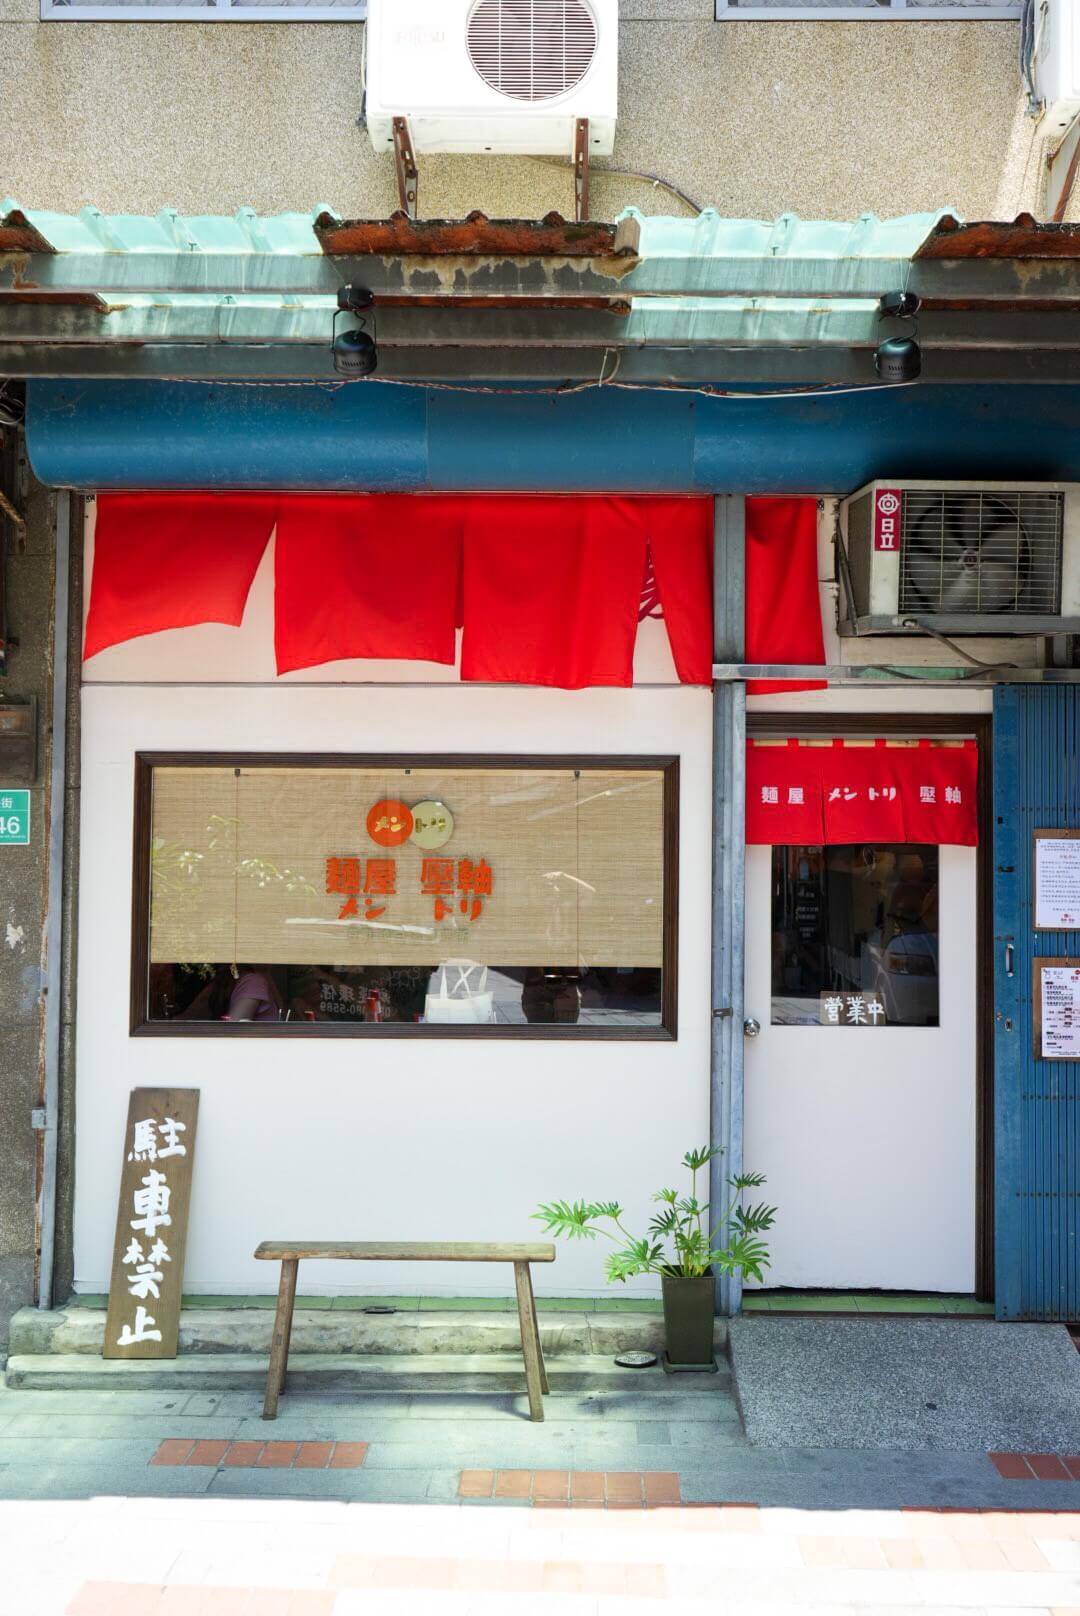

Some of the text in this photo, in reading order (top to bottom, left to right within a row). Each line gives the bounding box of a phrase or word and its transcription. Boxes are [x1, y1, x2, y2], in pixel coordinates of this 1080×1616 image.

[880, 518, 895, 549] 日立
[114, 1117, 187, 1346] 駐車禁止
